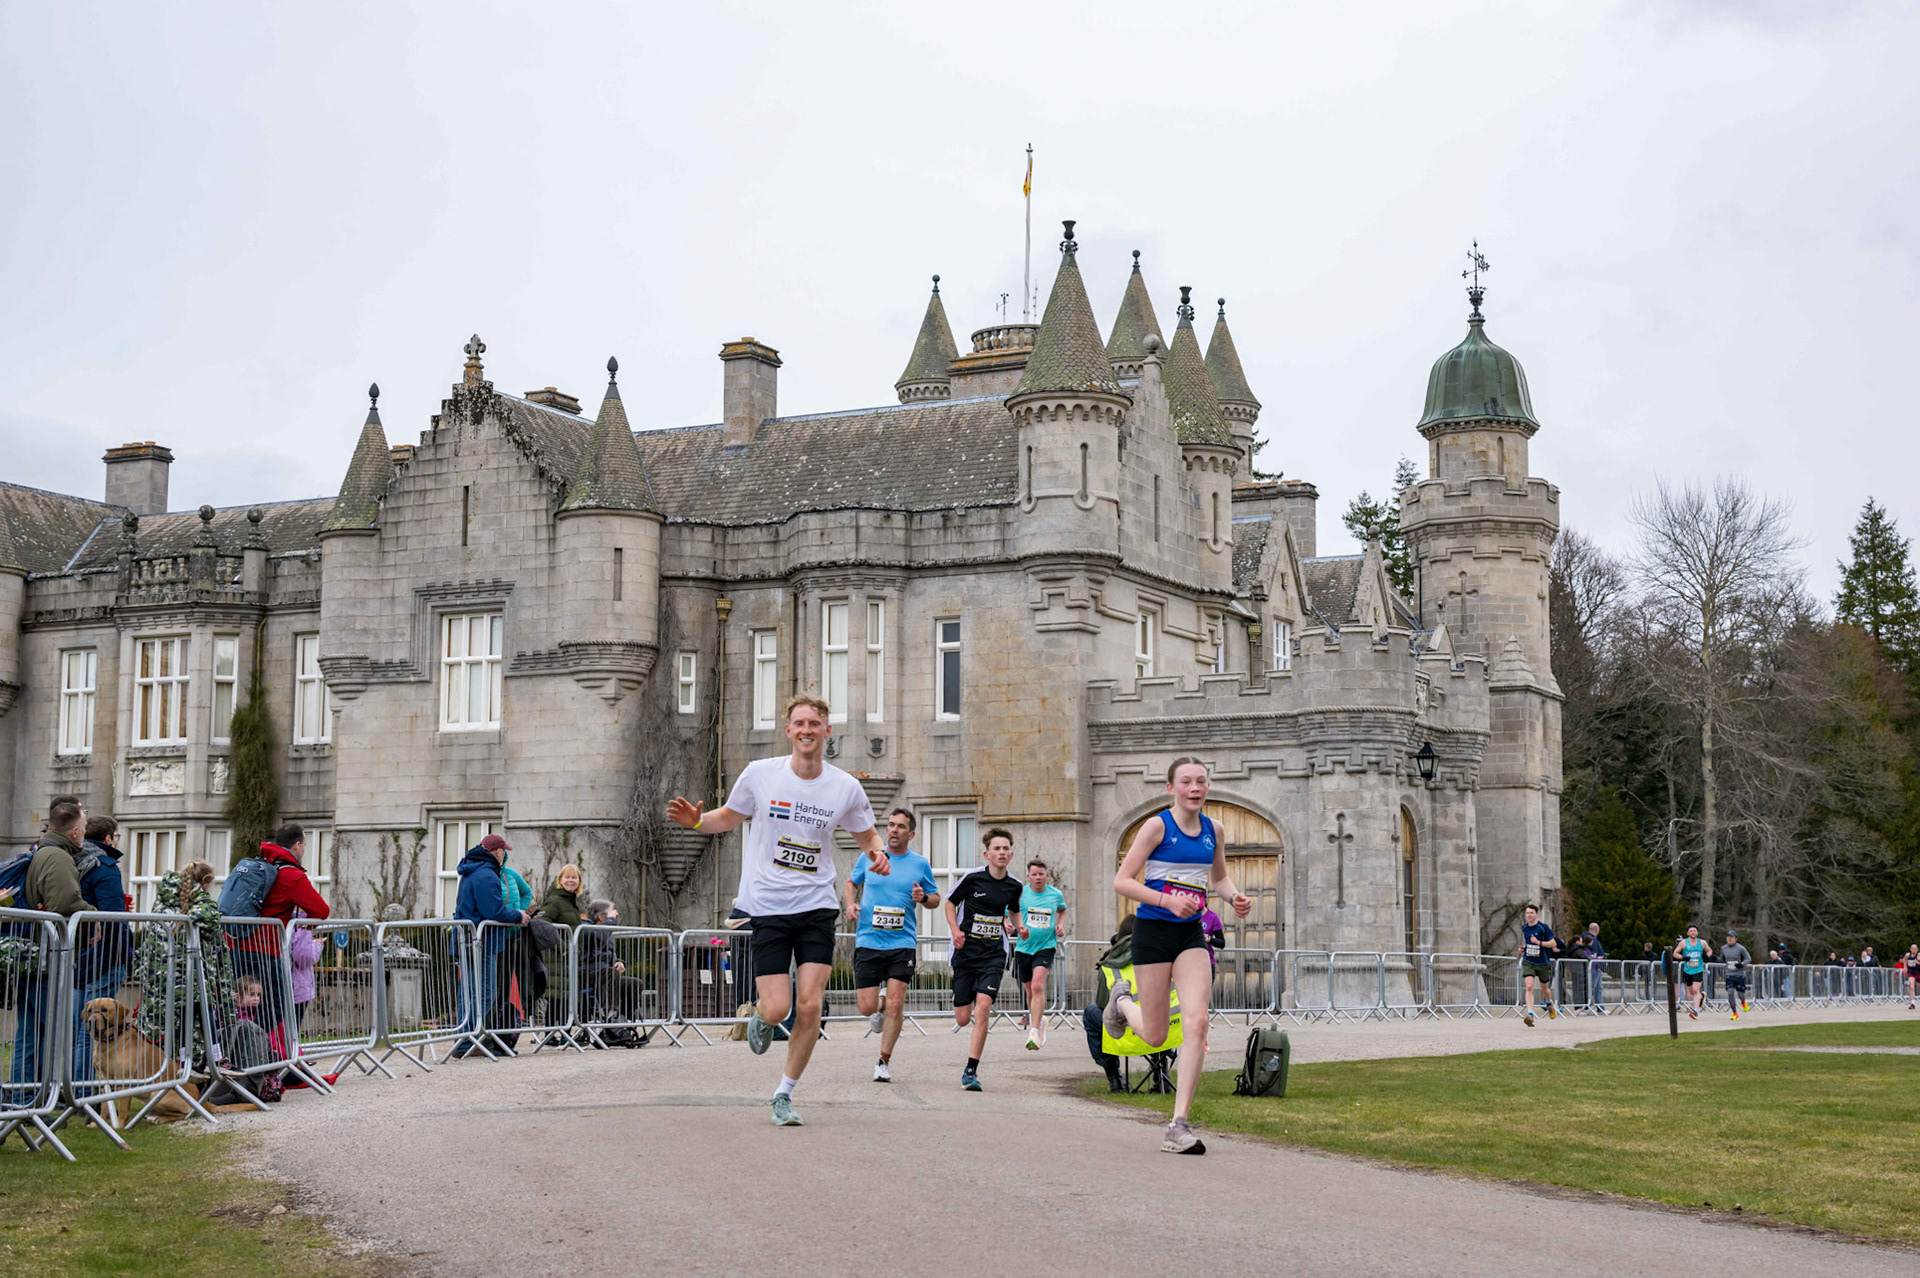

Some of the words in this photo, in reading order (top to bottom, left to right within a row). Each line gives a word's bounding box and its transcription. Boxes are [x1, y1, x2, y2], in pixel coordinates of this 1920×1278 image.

[795, 802, 834, 817] Harbour
[794, 812, 828, 829] Energy
[781, 849, 815, 865] 2190
[876, 917, 900, 925] 2344
[977, 925, 1000, 934] 2345
